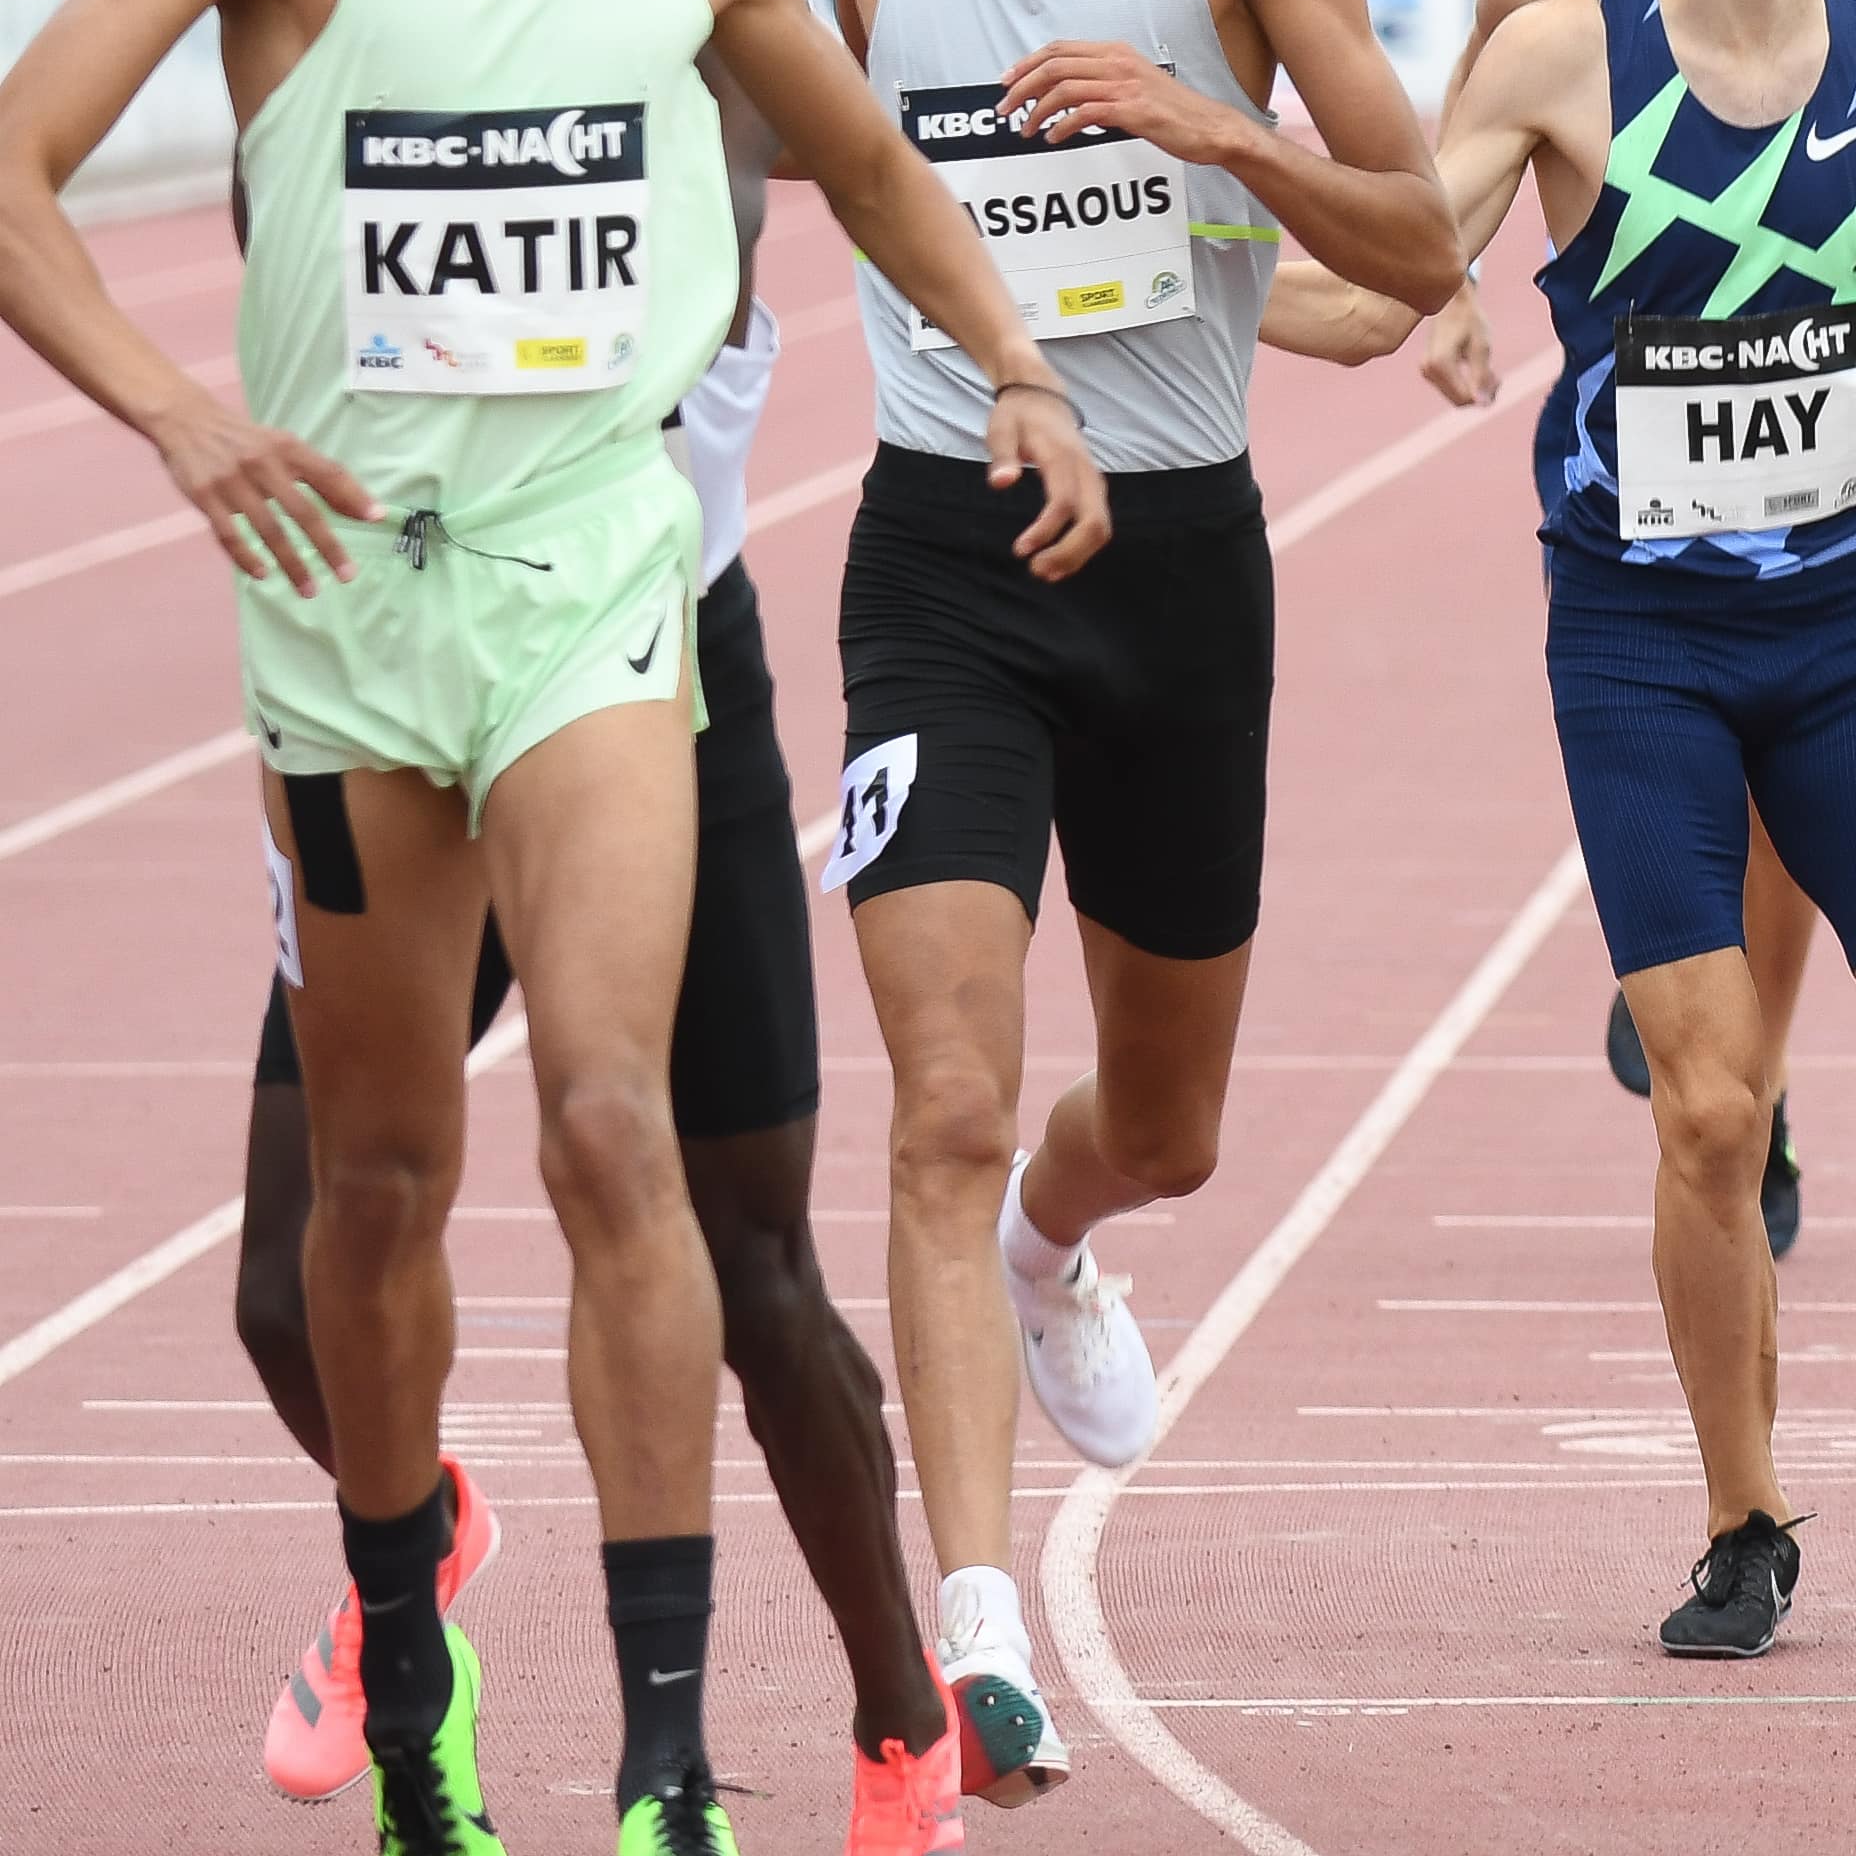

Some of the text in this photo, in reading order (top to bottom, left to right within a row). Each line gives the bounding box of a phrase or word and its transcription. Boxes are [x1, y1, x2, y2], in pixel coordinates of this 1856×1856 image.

[362, 109, 627, 177] KBC-NACHT
[361, 213, 640, 296] KATIR
[359, 355, 405, 369] KBC
[1686, 387, 1831, 464] HAY
